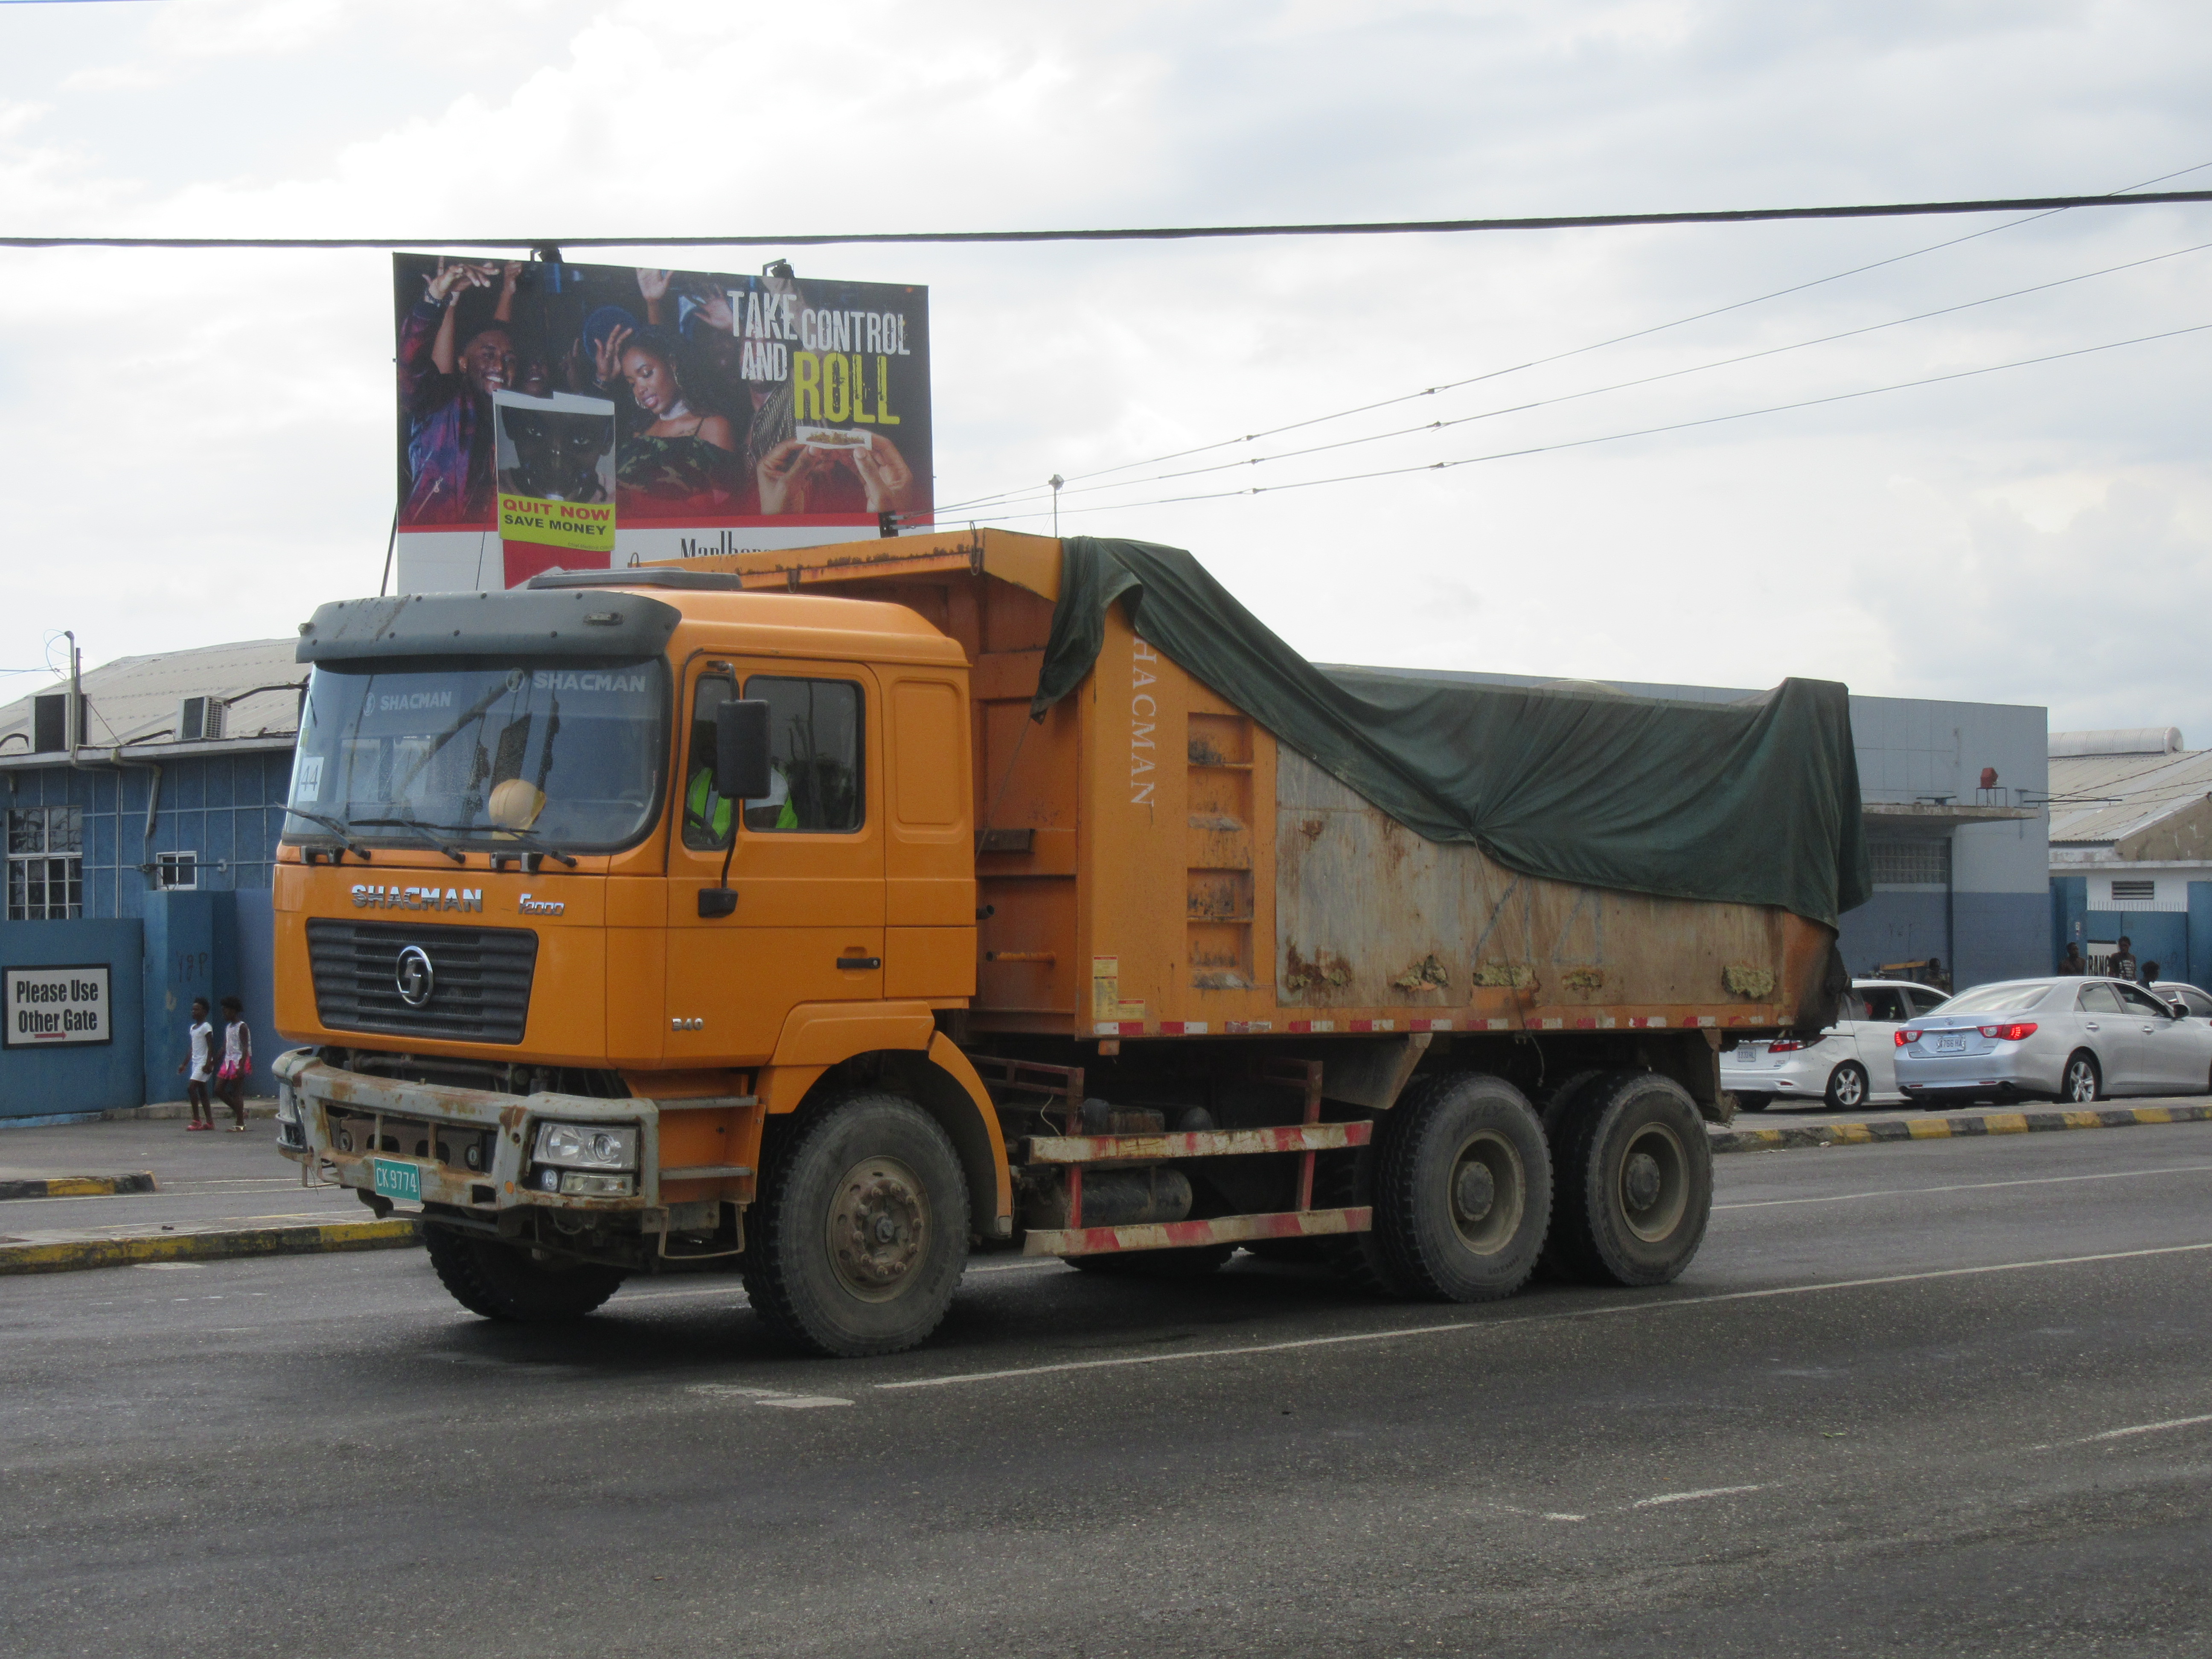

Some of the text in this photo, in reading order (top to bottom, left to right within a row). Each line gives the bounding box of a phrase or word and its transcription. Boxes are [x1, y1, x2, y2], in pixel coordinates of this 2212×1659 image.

[727, 291, 910, 355] TAKE CONTROL
[741, 341, 900, 425] AND ROLL
[503, 499, 611, 521] QUIT NOW
[504, 514, 606, 535] SAVE MONEY
[681, 531, 771, 558] Marlb
[534, 672, 646, 692] SHACMAN
[380, 691, 452, 711] SHACMAN
[1131, 637, 1158, 807] HACMAN
[300, 765, 318, 792] 44
[351, 884, 565, 916] SHACMAN F2000
[17, 979, 98, 1003] Please Use
[19, 1008, 97, 1033] Other Gate
[377, 1168, 417, 1193] CK 9774
